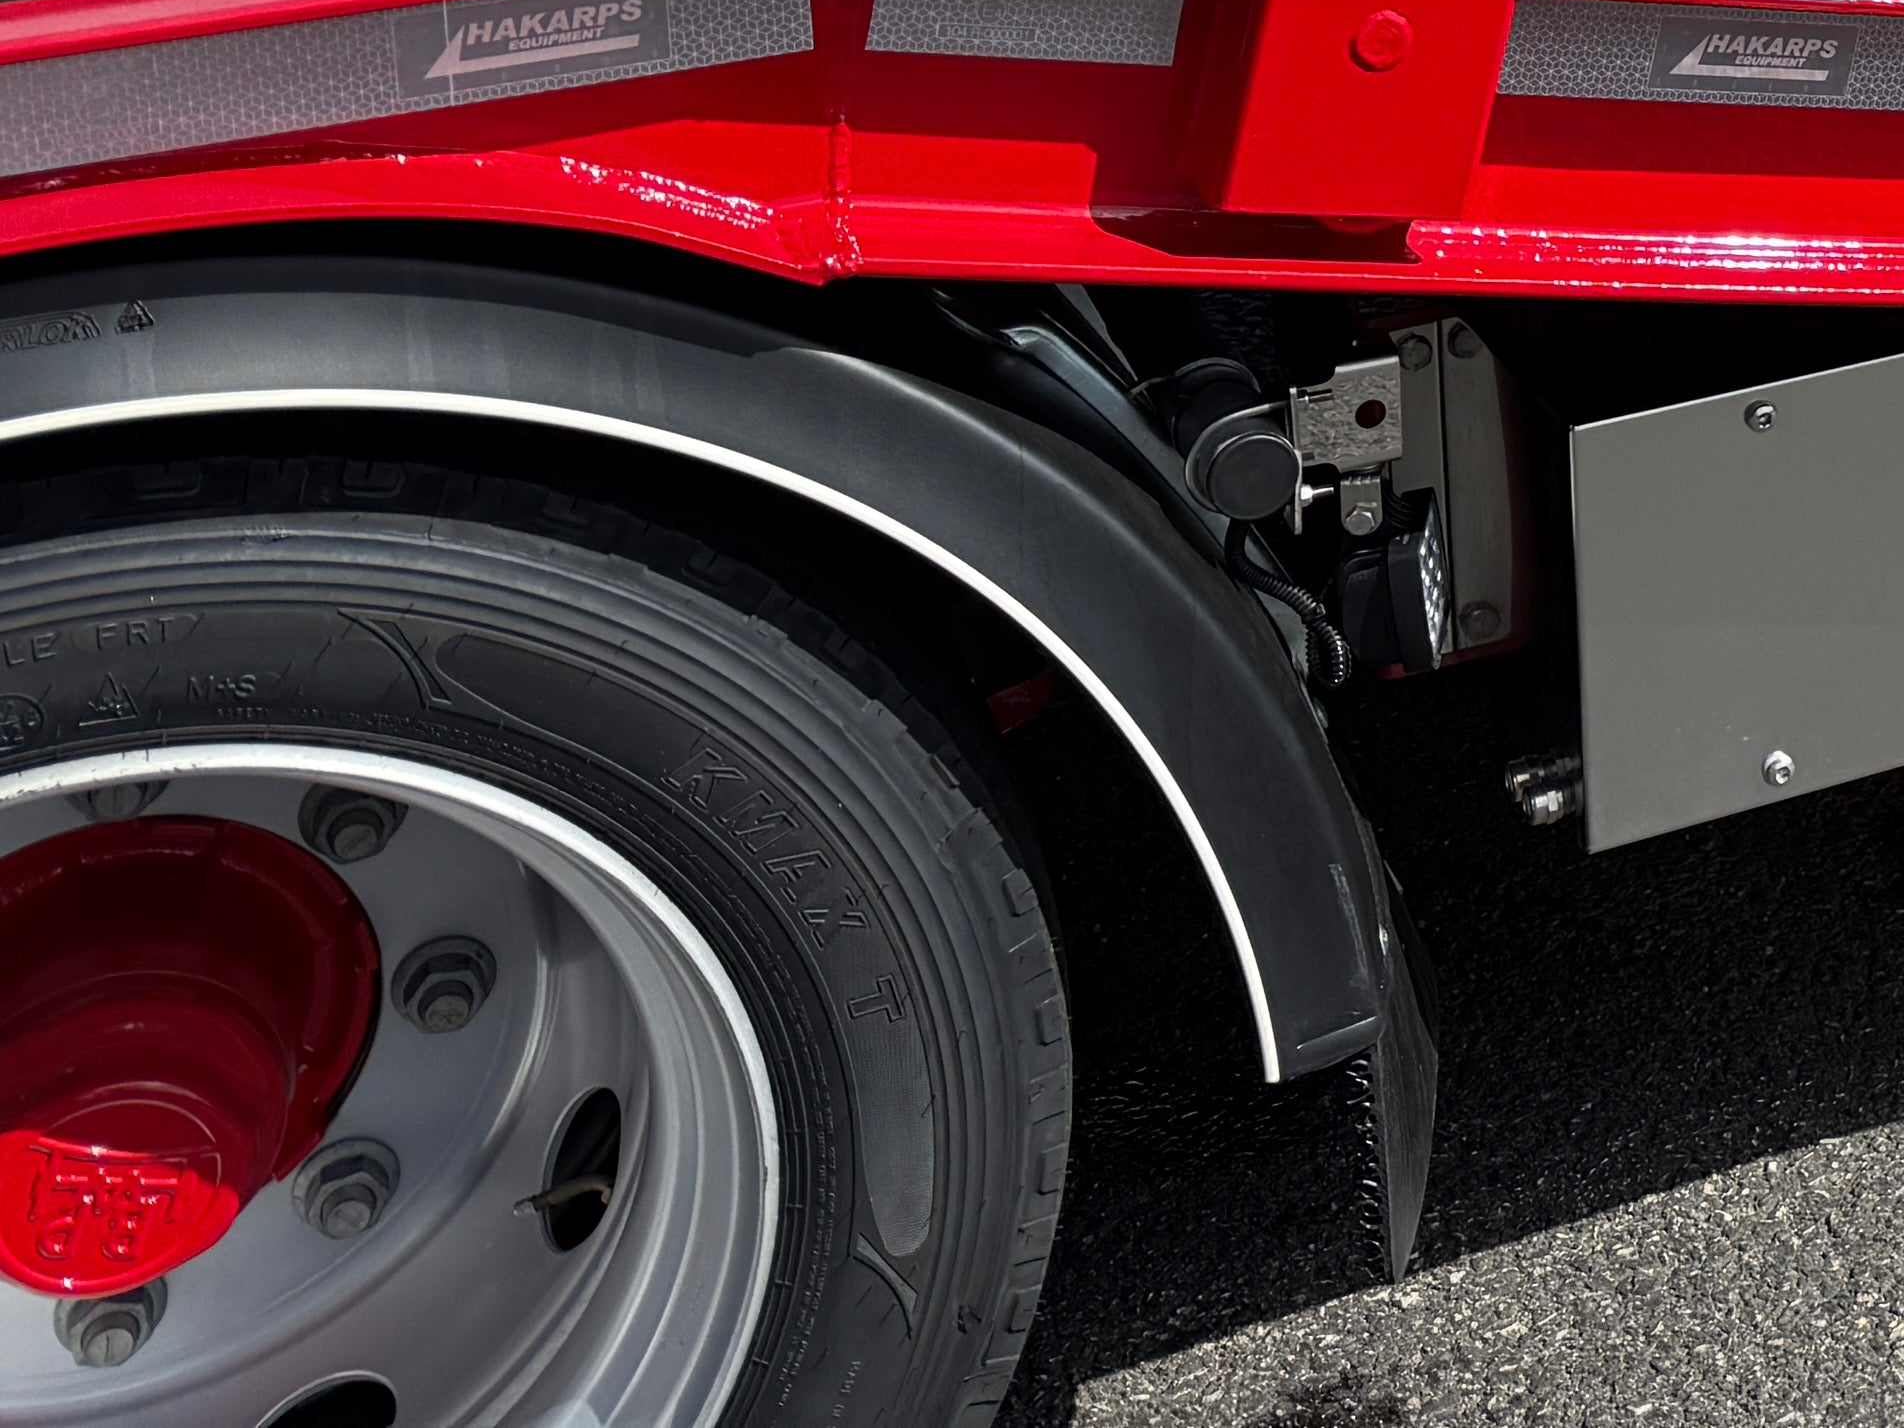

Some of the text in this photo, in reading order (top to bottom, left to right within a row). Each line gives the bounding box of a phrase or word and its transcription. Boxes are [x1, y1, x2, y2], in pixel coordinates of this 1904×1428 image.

[466, 0, 642, 45] HAKARPS
[508, 26, 605, 51] EQUIPMENT
[1707, 34, 1839, 59] HAKARPS
[1735, 55, 1806, 67] EQUIPMENT
[95, 615, 176, 650] FRT
[660, 746, 870, 952] KMAX
[845, 974, 906, 1024] T
